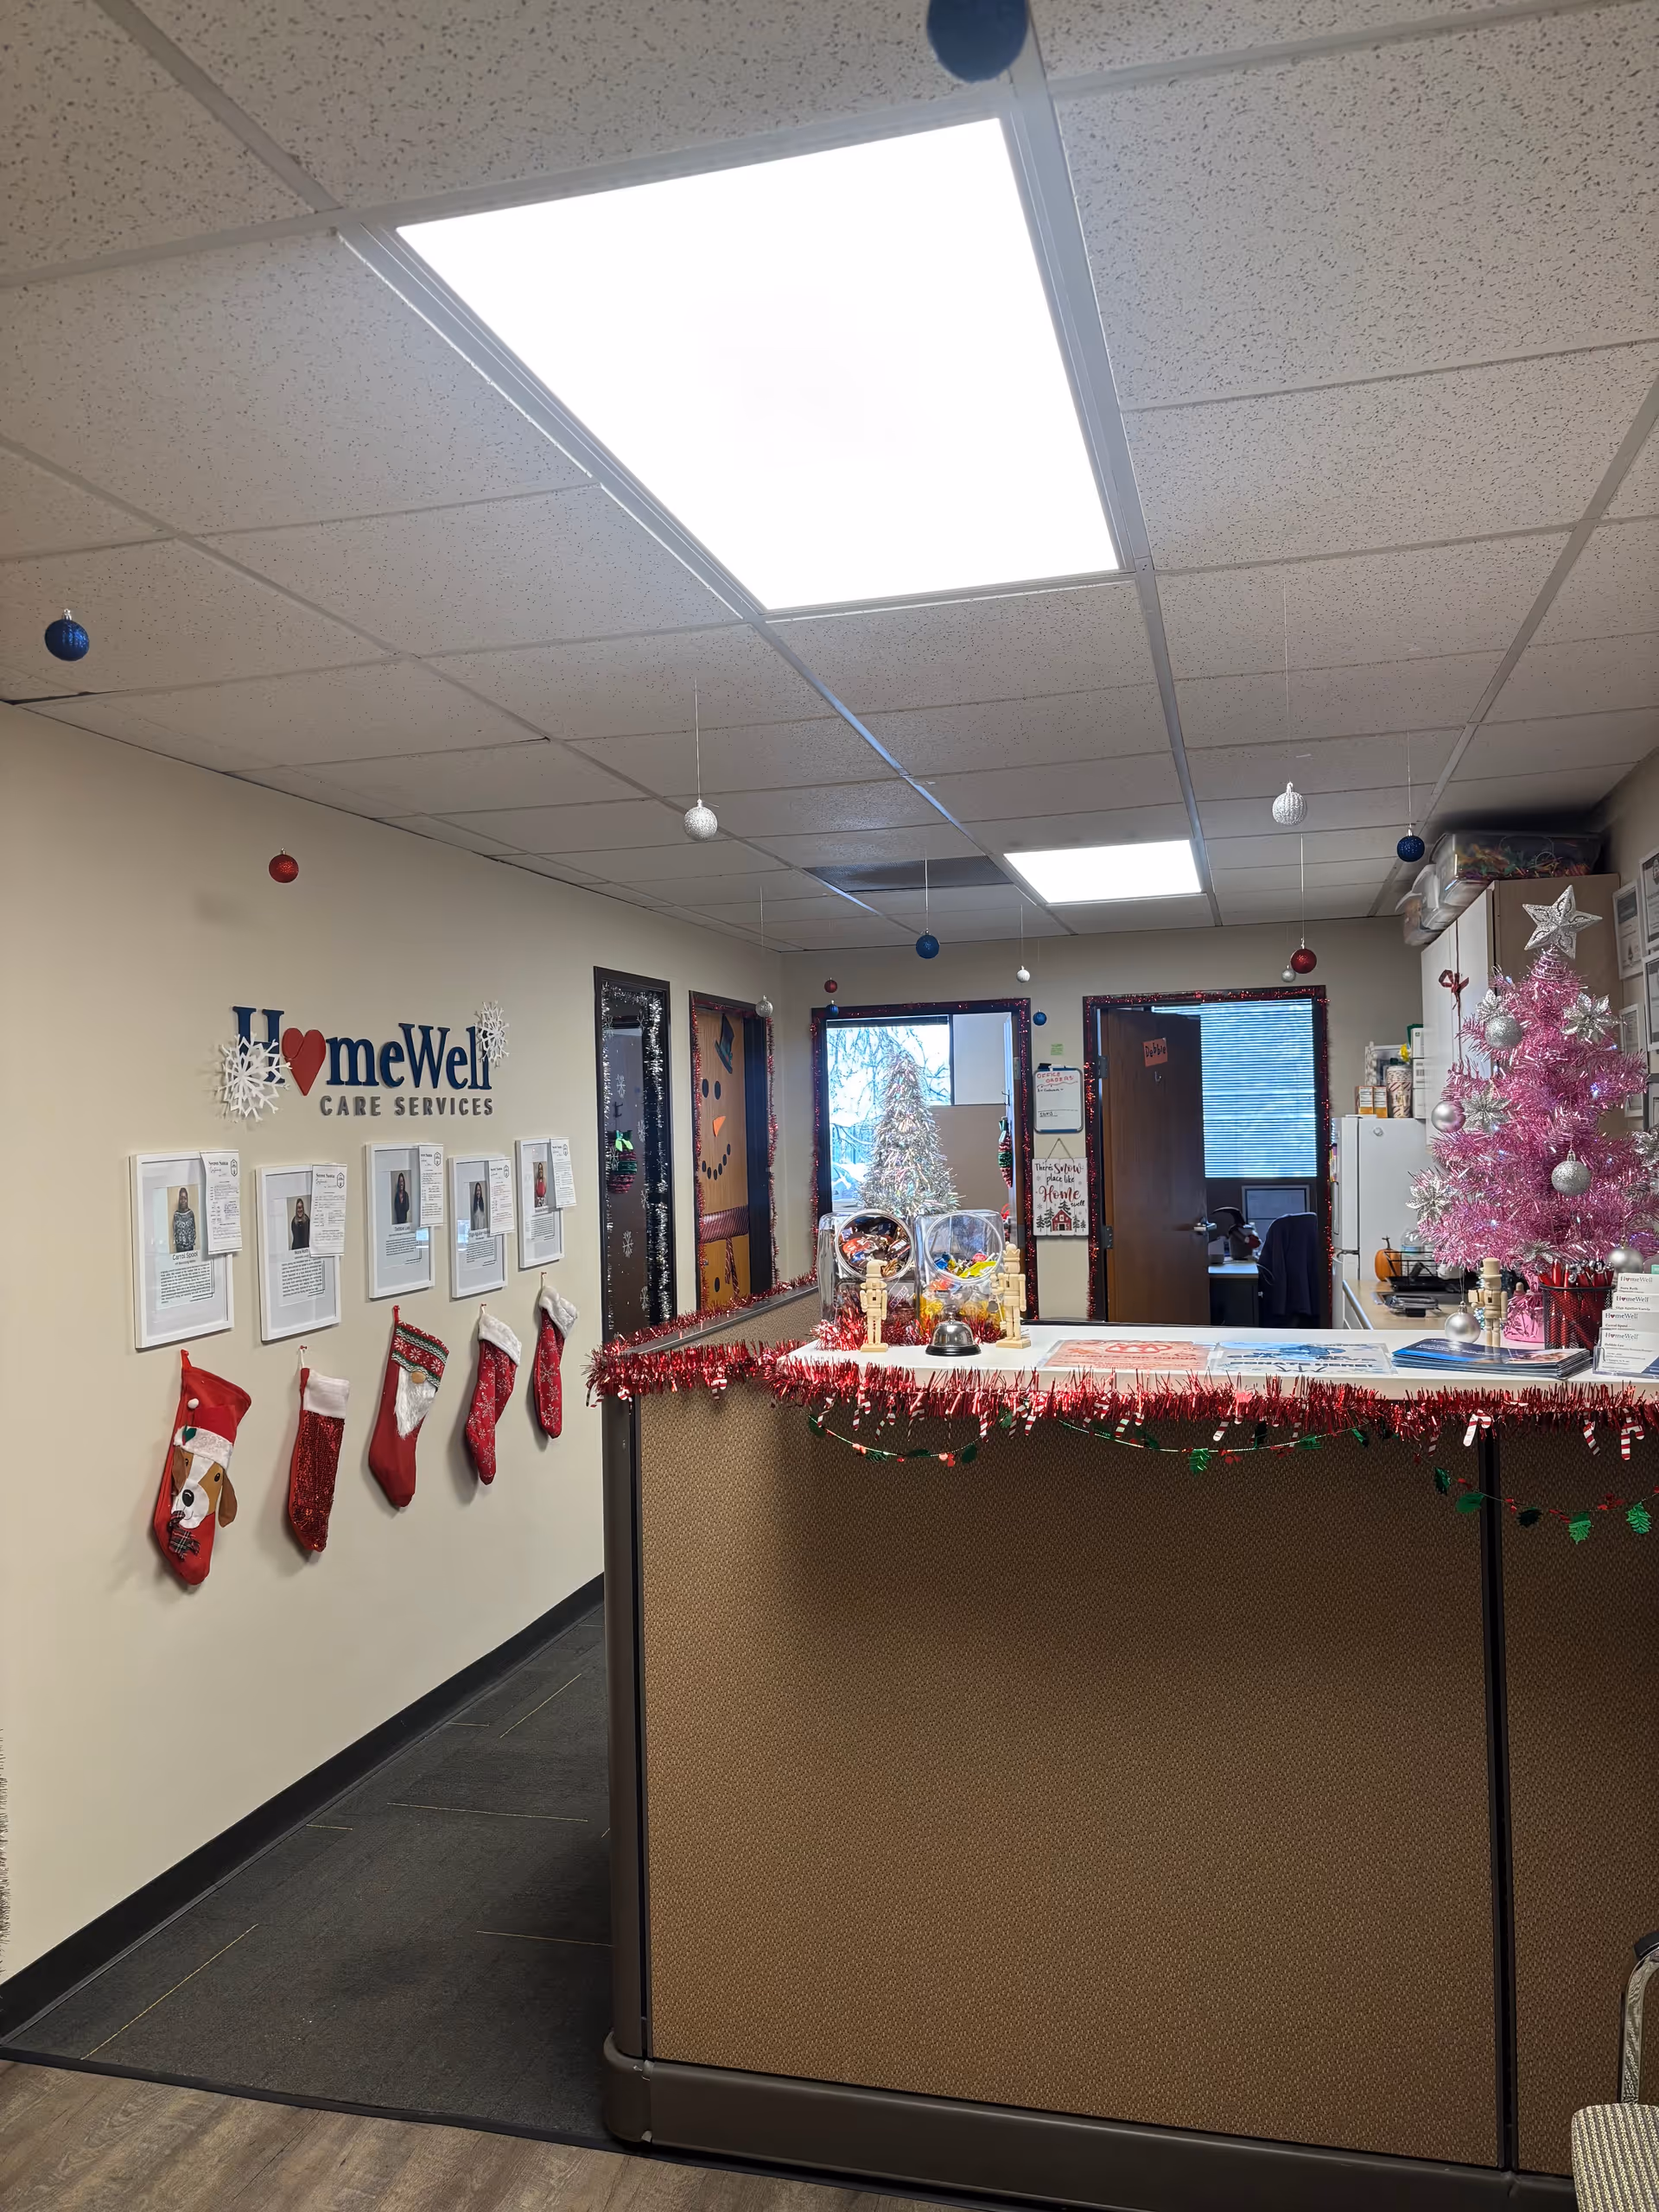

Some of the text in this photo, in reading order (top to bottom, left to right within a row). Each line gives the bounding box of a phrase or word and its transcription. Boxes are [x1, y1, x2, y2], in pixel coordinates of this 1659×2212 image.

[1145, 1042, 1166, 1058] Debbie
[1046, 1075, 1074, 1084] ORDERS
[320, 1095, 493, 1116] CARE SERVICES
[1034, 1162, 1083, 1174] There's Snow
[1046, 1173, 1075, 1185] place like
[1039, 1185, 1082, 1204] Home
